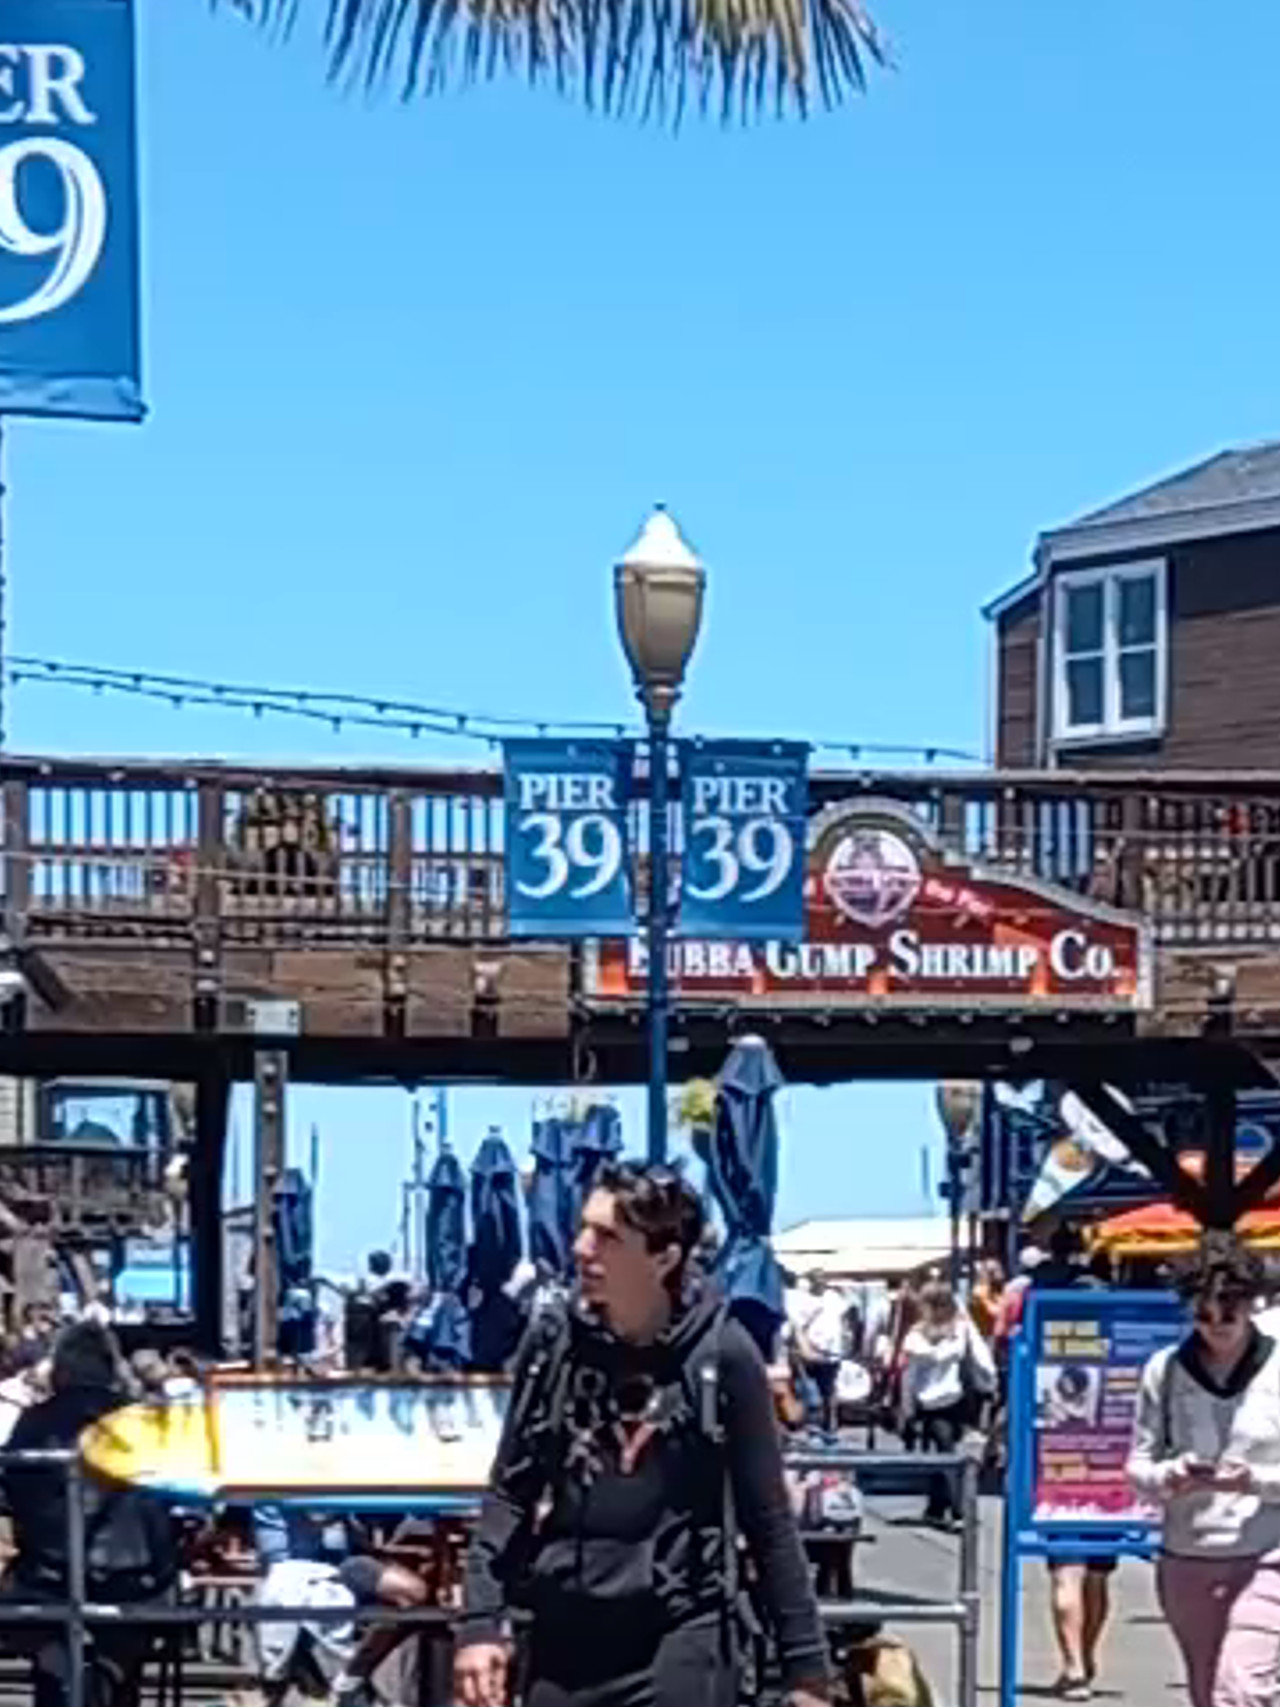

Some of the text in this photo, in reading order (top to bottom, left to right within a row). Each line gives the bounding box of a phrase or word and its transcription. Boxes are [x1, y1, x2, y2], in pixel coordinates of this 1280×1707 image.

[518, 772, 618, 811] PIER
[691, 775, 790, 814] PIER
[515, 812, 622, 899] 39
[684, 816, 794, 902] 39
[765, 938, 878, 979] GUMP
[888, 929, 1039, 979] SHRIMP
